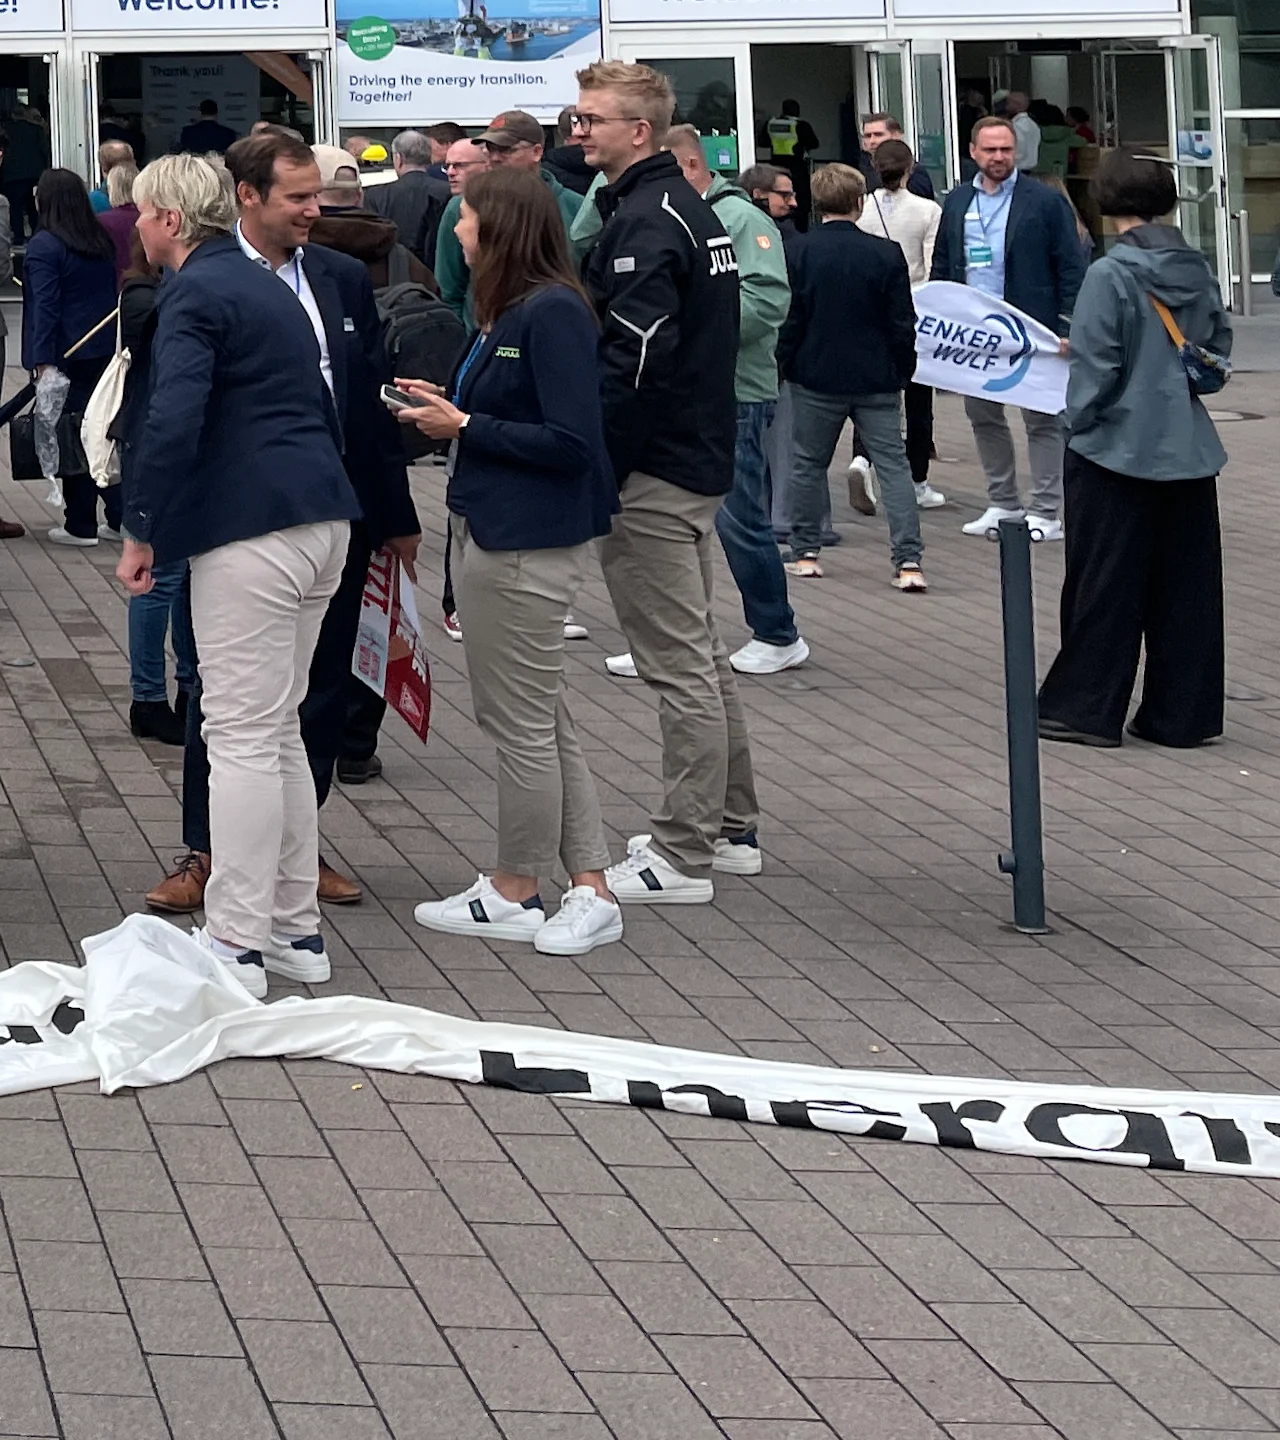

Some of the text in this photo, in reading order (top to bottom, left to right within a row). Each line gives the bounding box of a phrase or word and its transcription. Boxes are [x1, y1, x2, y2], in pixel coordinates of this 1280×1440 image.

[349, 72, 548, 89] Driving the energy transition.
[348, 91, 413, 105] Together!
[915, 314, 1003, 353] ENKER
[932, 342, 1000, 372] WULF
